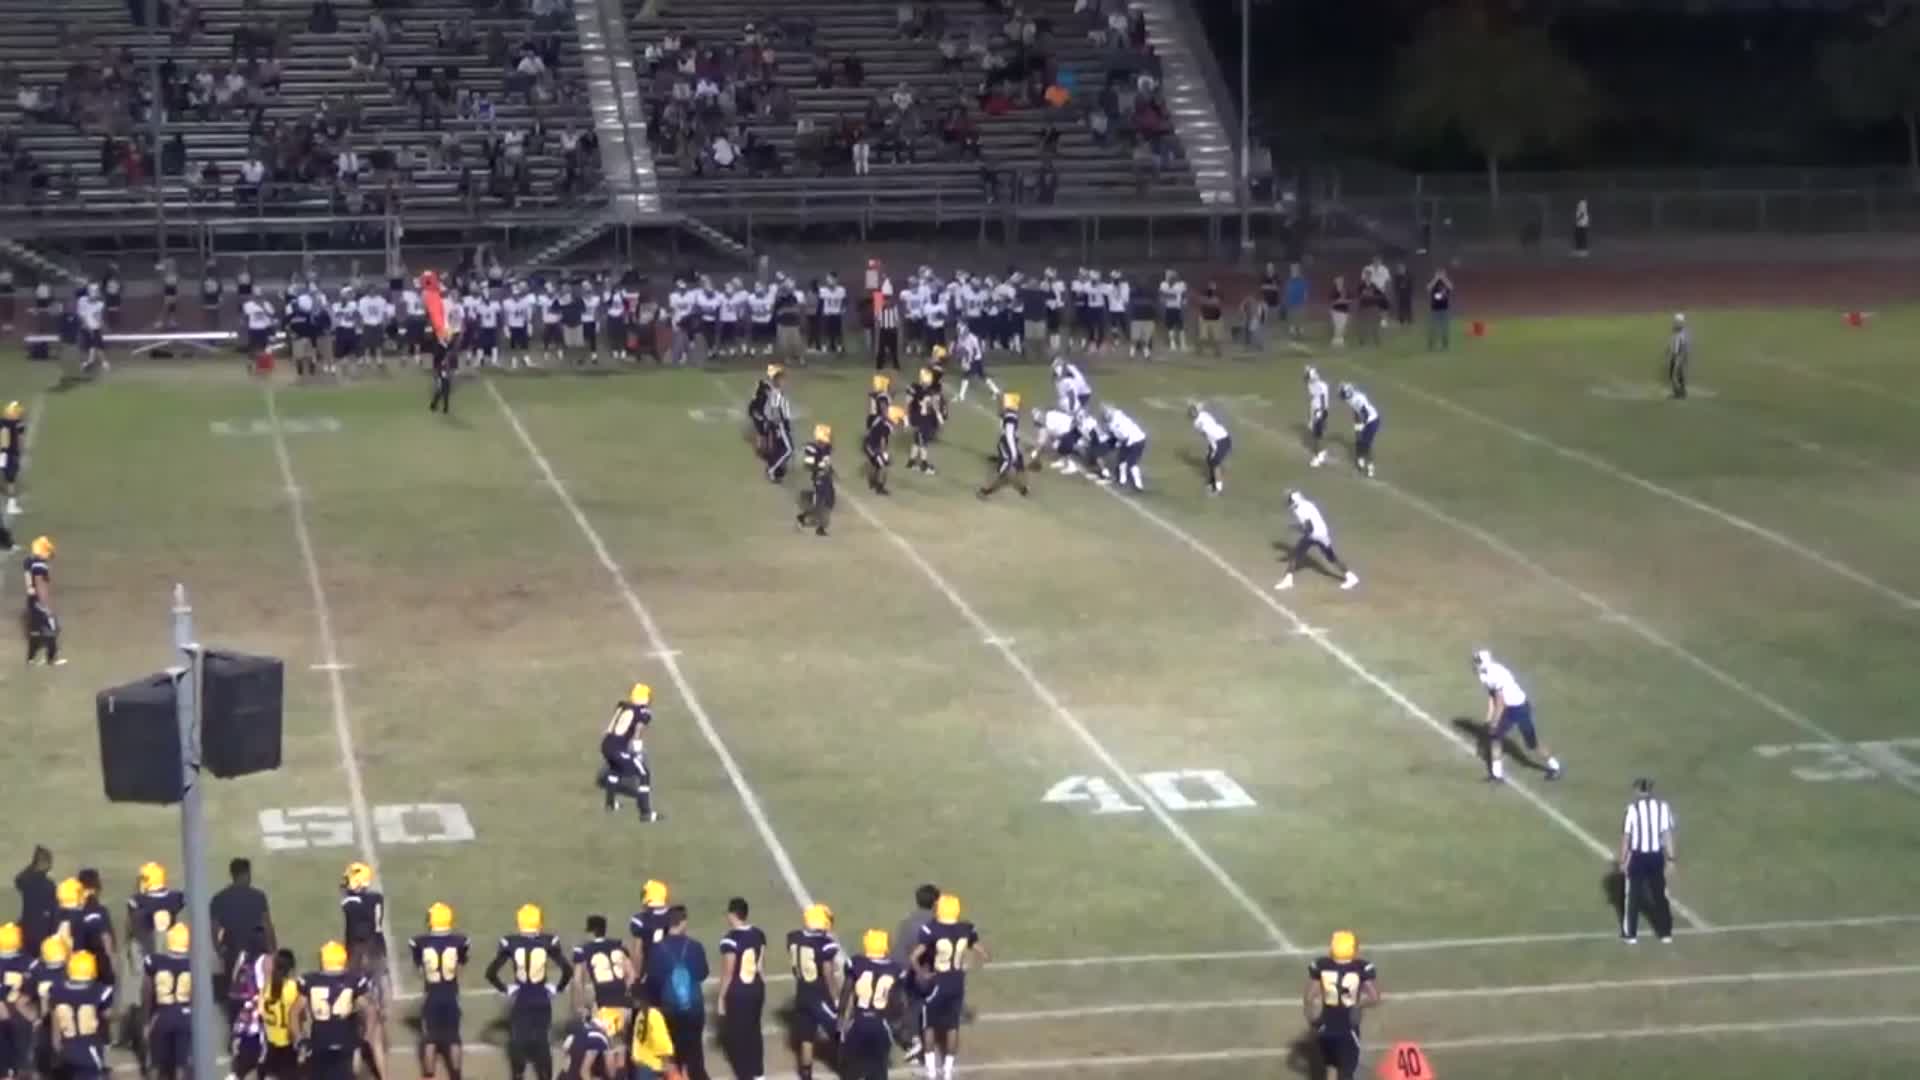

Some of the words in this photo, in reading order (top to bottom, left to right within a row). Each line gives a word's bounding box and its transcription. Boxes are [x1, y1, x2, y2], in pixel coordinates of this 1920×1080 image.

[1040, 769, 1257, 814] 40
[258, 803, 476, 850] 50
[309, 986, 353, 1022] 54
[1397, 1047, 1422, 1079] 40
